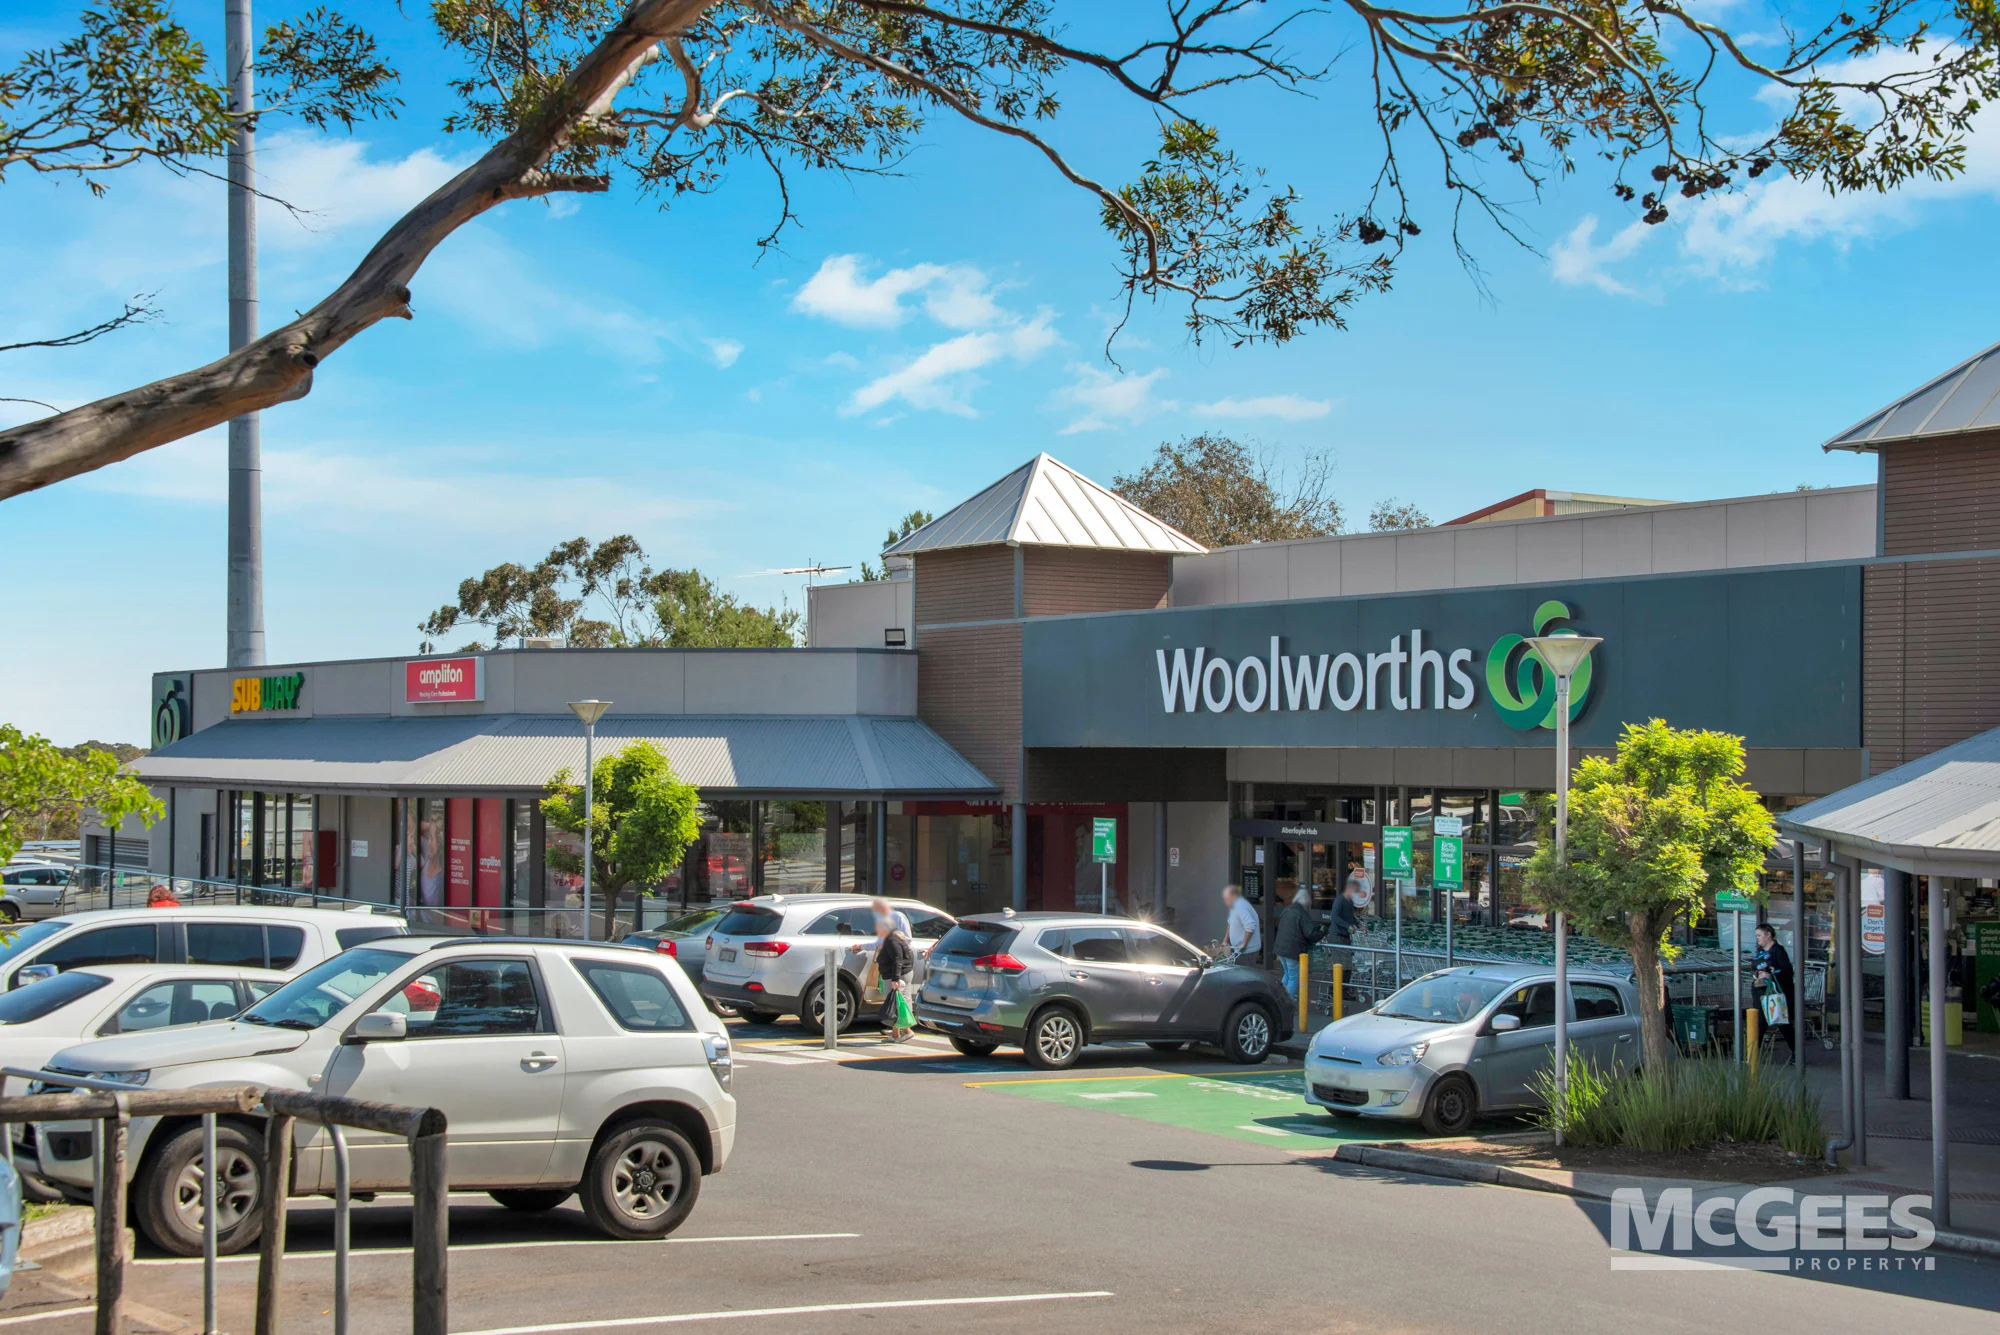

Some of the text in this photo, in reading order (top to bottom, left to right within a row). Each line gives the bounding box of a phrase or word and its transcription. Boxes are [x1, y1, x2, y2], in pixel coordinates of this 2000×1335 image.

[419, 664, 463, 689] amplifon
[1156, 629, 1474, 713] Woolworths
[230, 672, 304, 714] SUBWAY
[1282, 827, 1306, 836] Aberfoyle
[480, 856, 501, 868] amplifon
[1445, 866, 1451, 878] 1
[1863, 925, 1881, 933] forget
